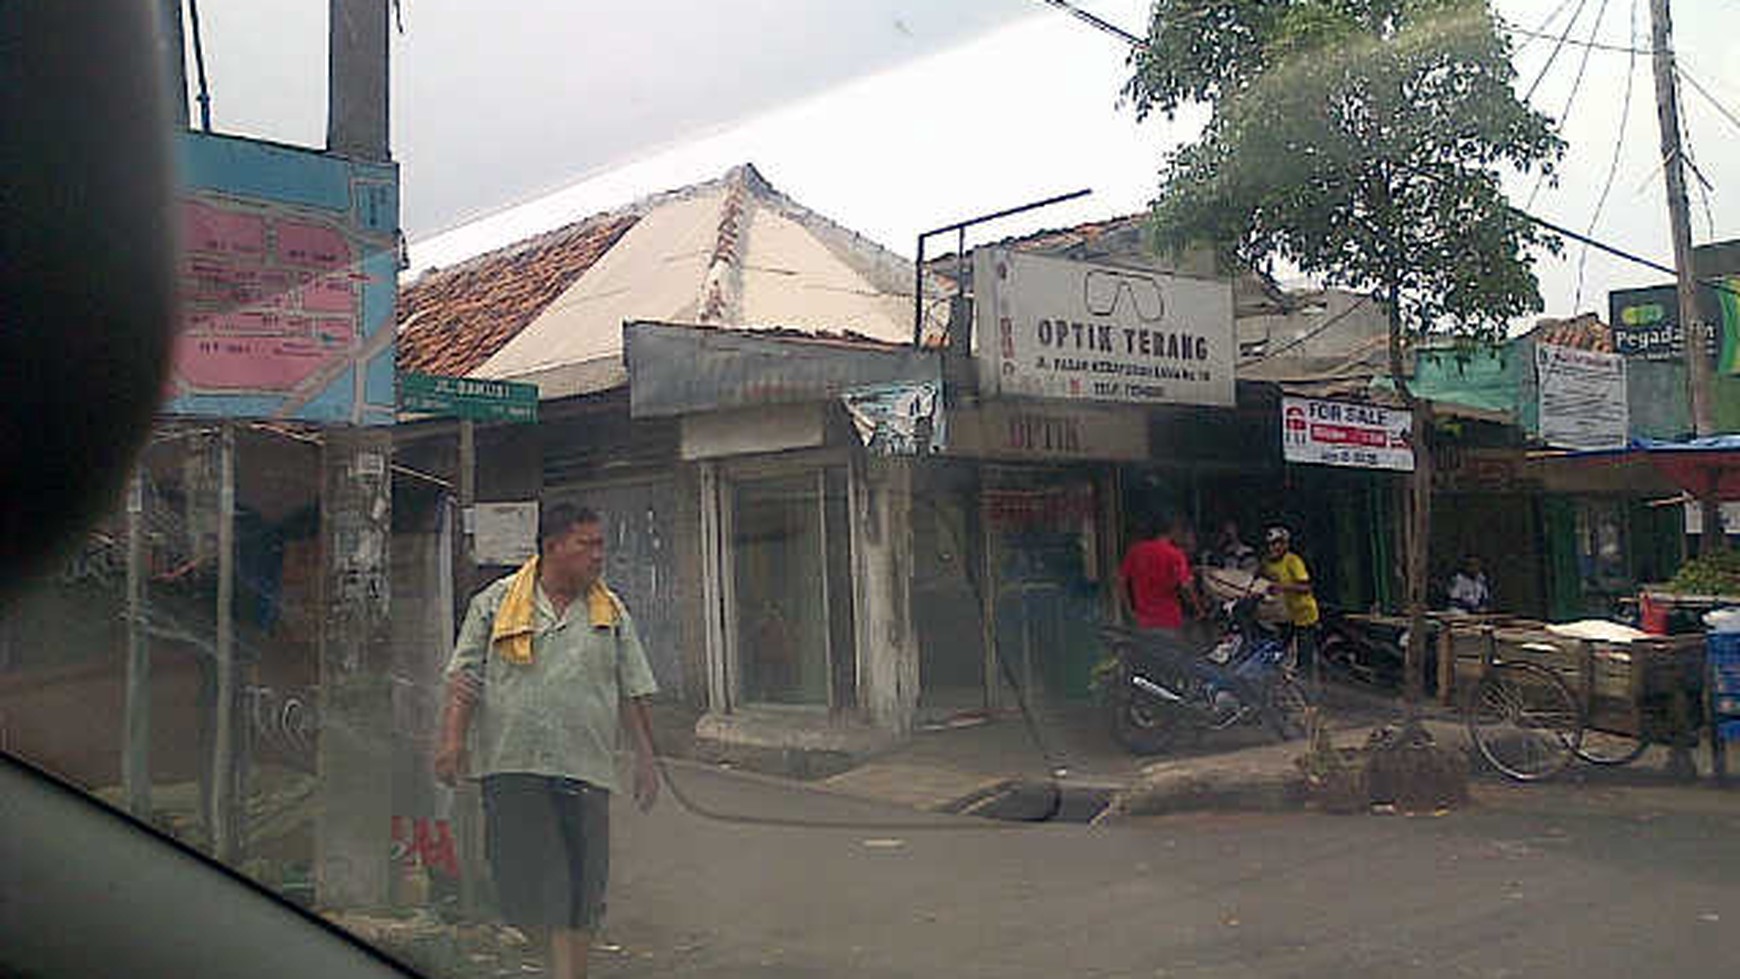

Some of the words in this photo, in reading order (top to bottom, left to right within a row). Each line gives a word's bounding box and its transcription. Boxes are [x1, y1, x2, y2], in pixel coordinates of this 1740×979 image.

[1038, 319, 1112, 352] OPTIK
[1123, 328, 1208, 360] TERANG
[1615, 324, 1716, 349] Pegadan
[1308, 402, 1342, 421] FOR
[1345, 406, 1388, 425] SALE
